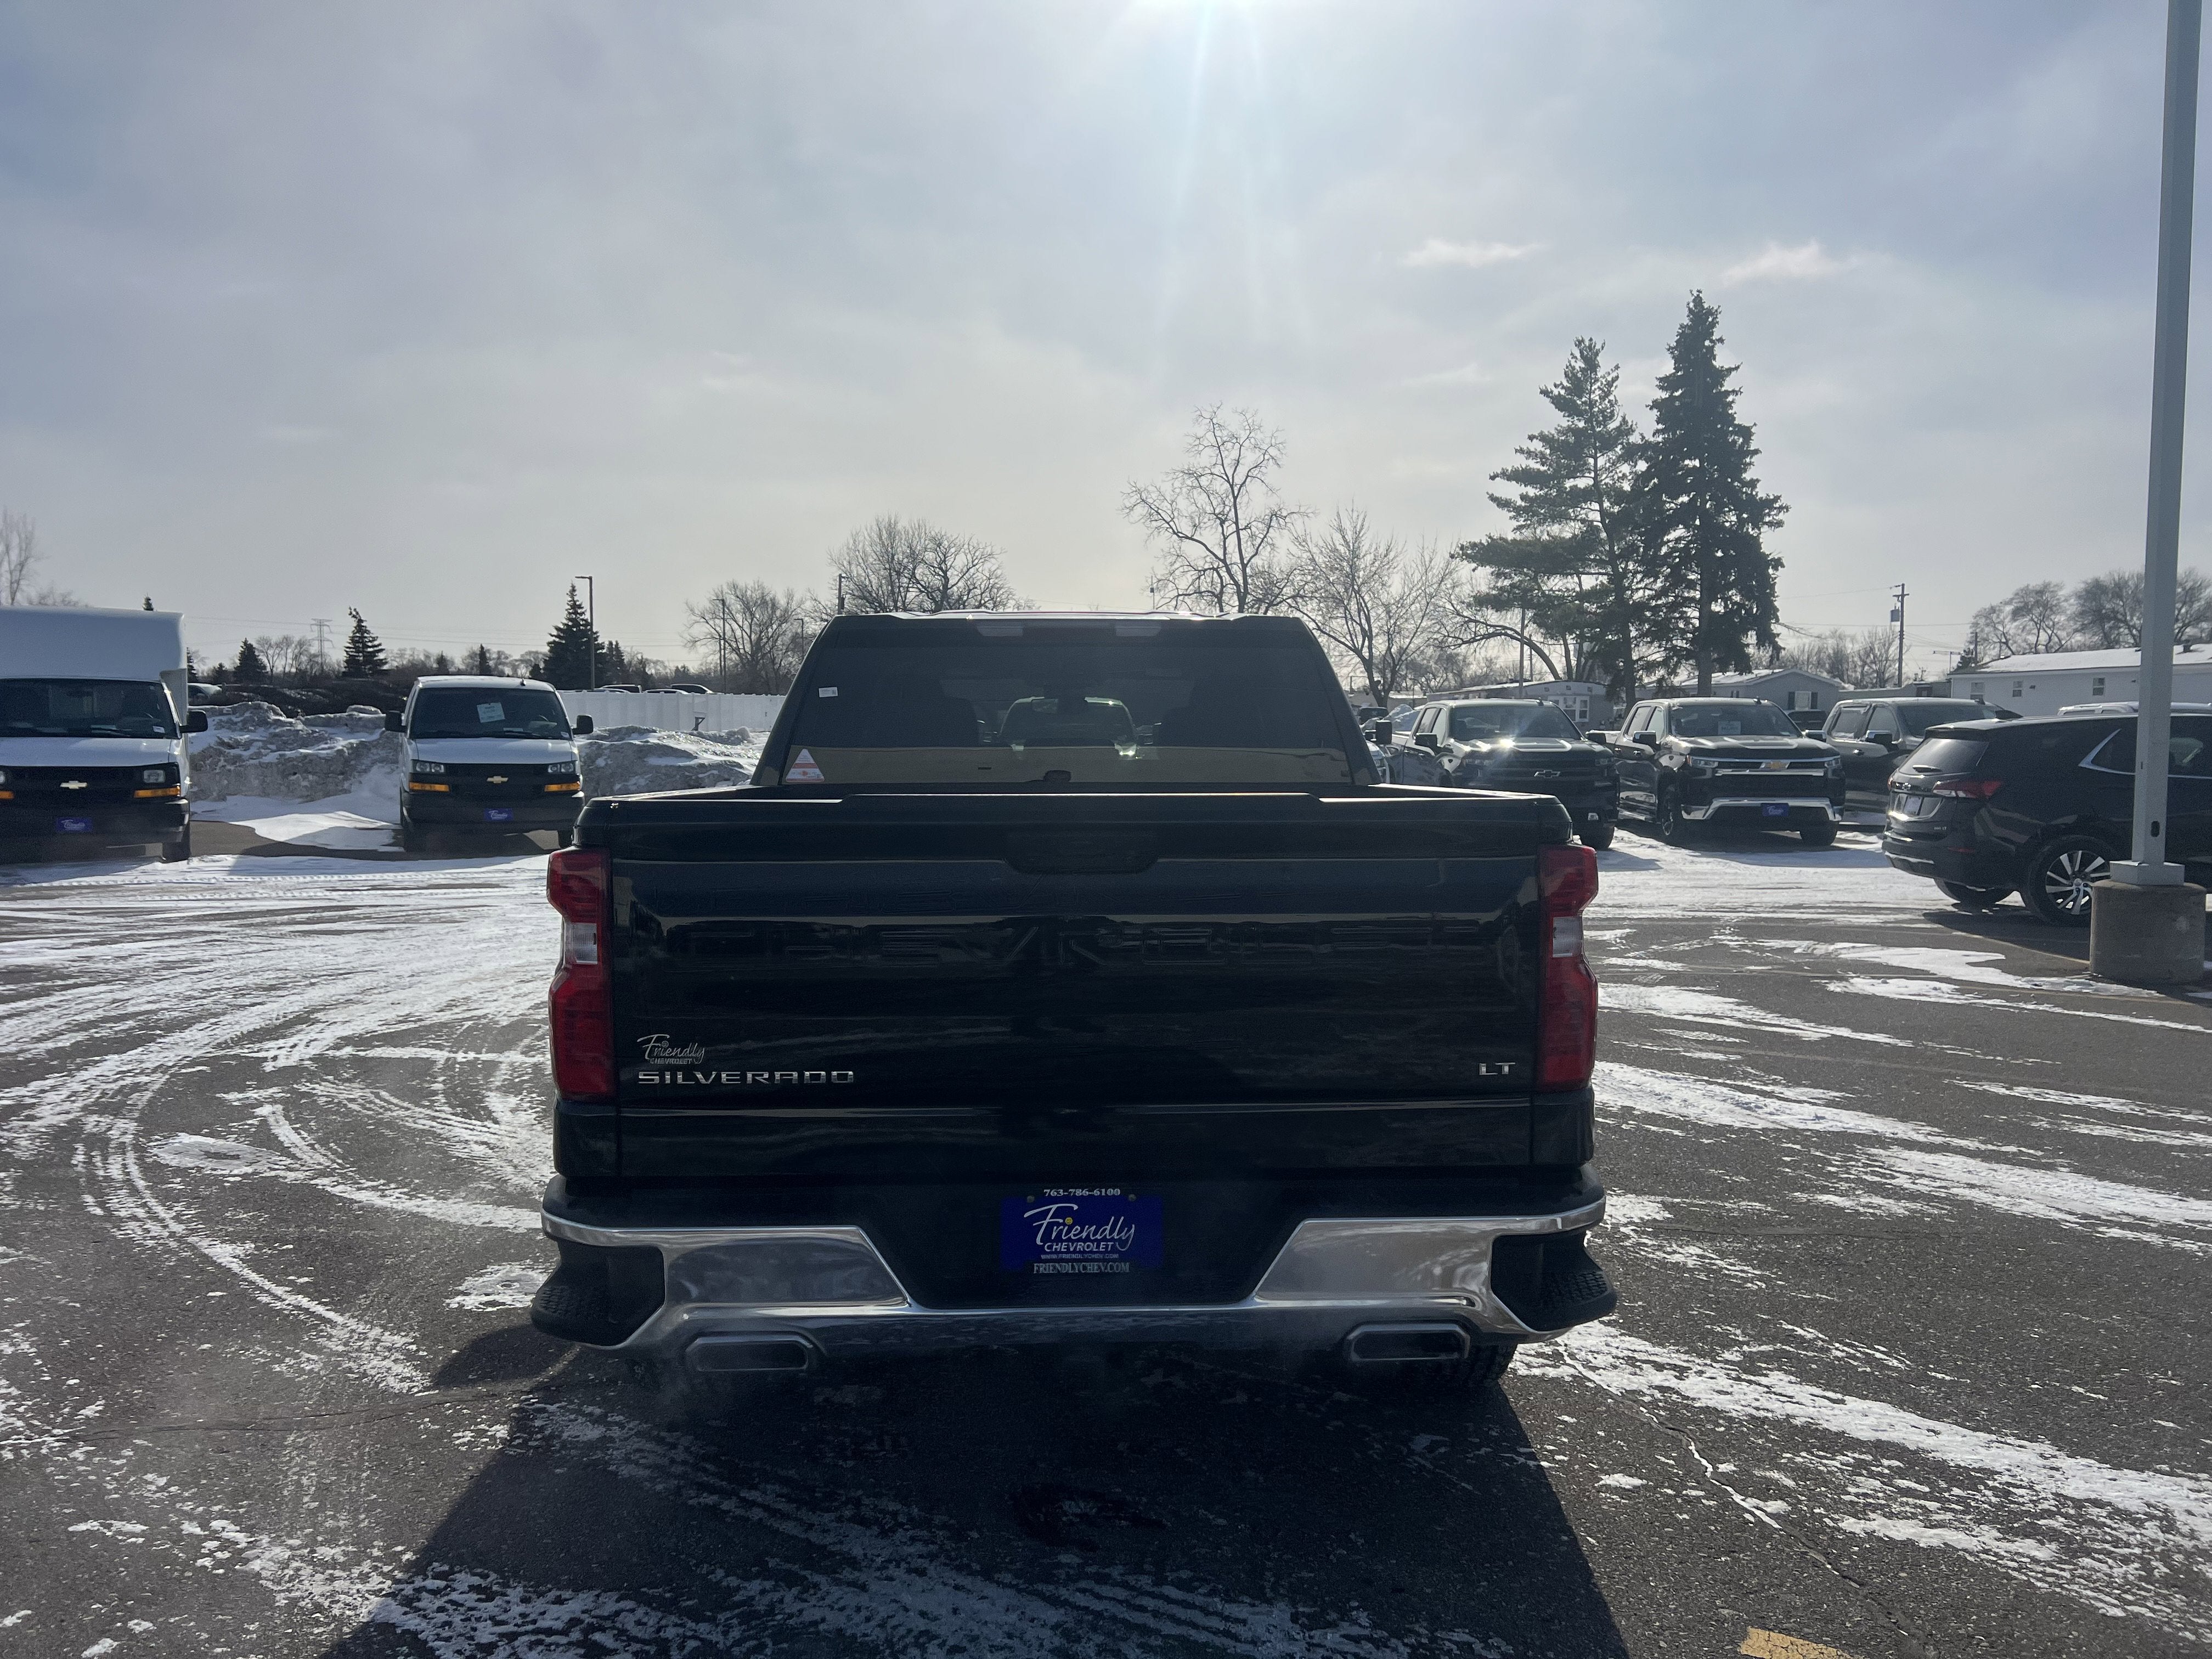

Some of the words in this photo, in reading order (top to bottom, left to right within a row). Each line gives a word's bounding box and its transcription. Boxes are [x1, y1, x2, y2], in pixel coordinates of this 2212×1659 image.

[637, 1034, 705, 1064] Friendly
[1479, 1062, 1516, 1075] LT
[637, 1071, 854, 1084] SILVERADO
[1024, 1203, 1135, 1251] Friendly
[1045, 1242, 1114, 1251] CHEVROLET
[1033, 1262, 1130, 1273] FRIENDLYCHEV.COM
